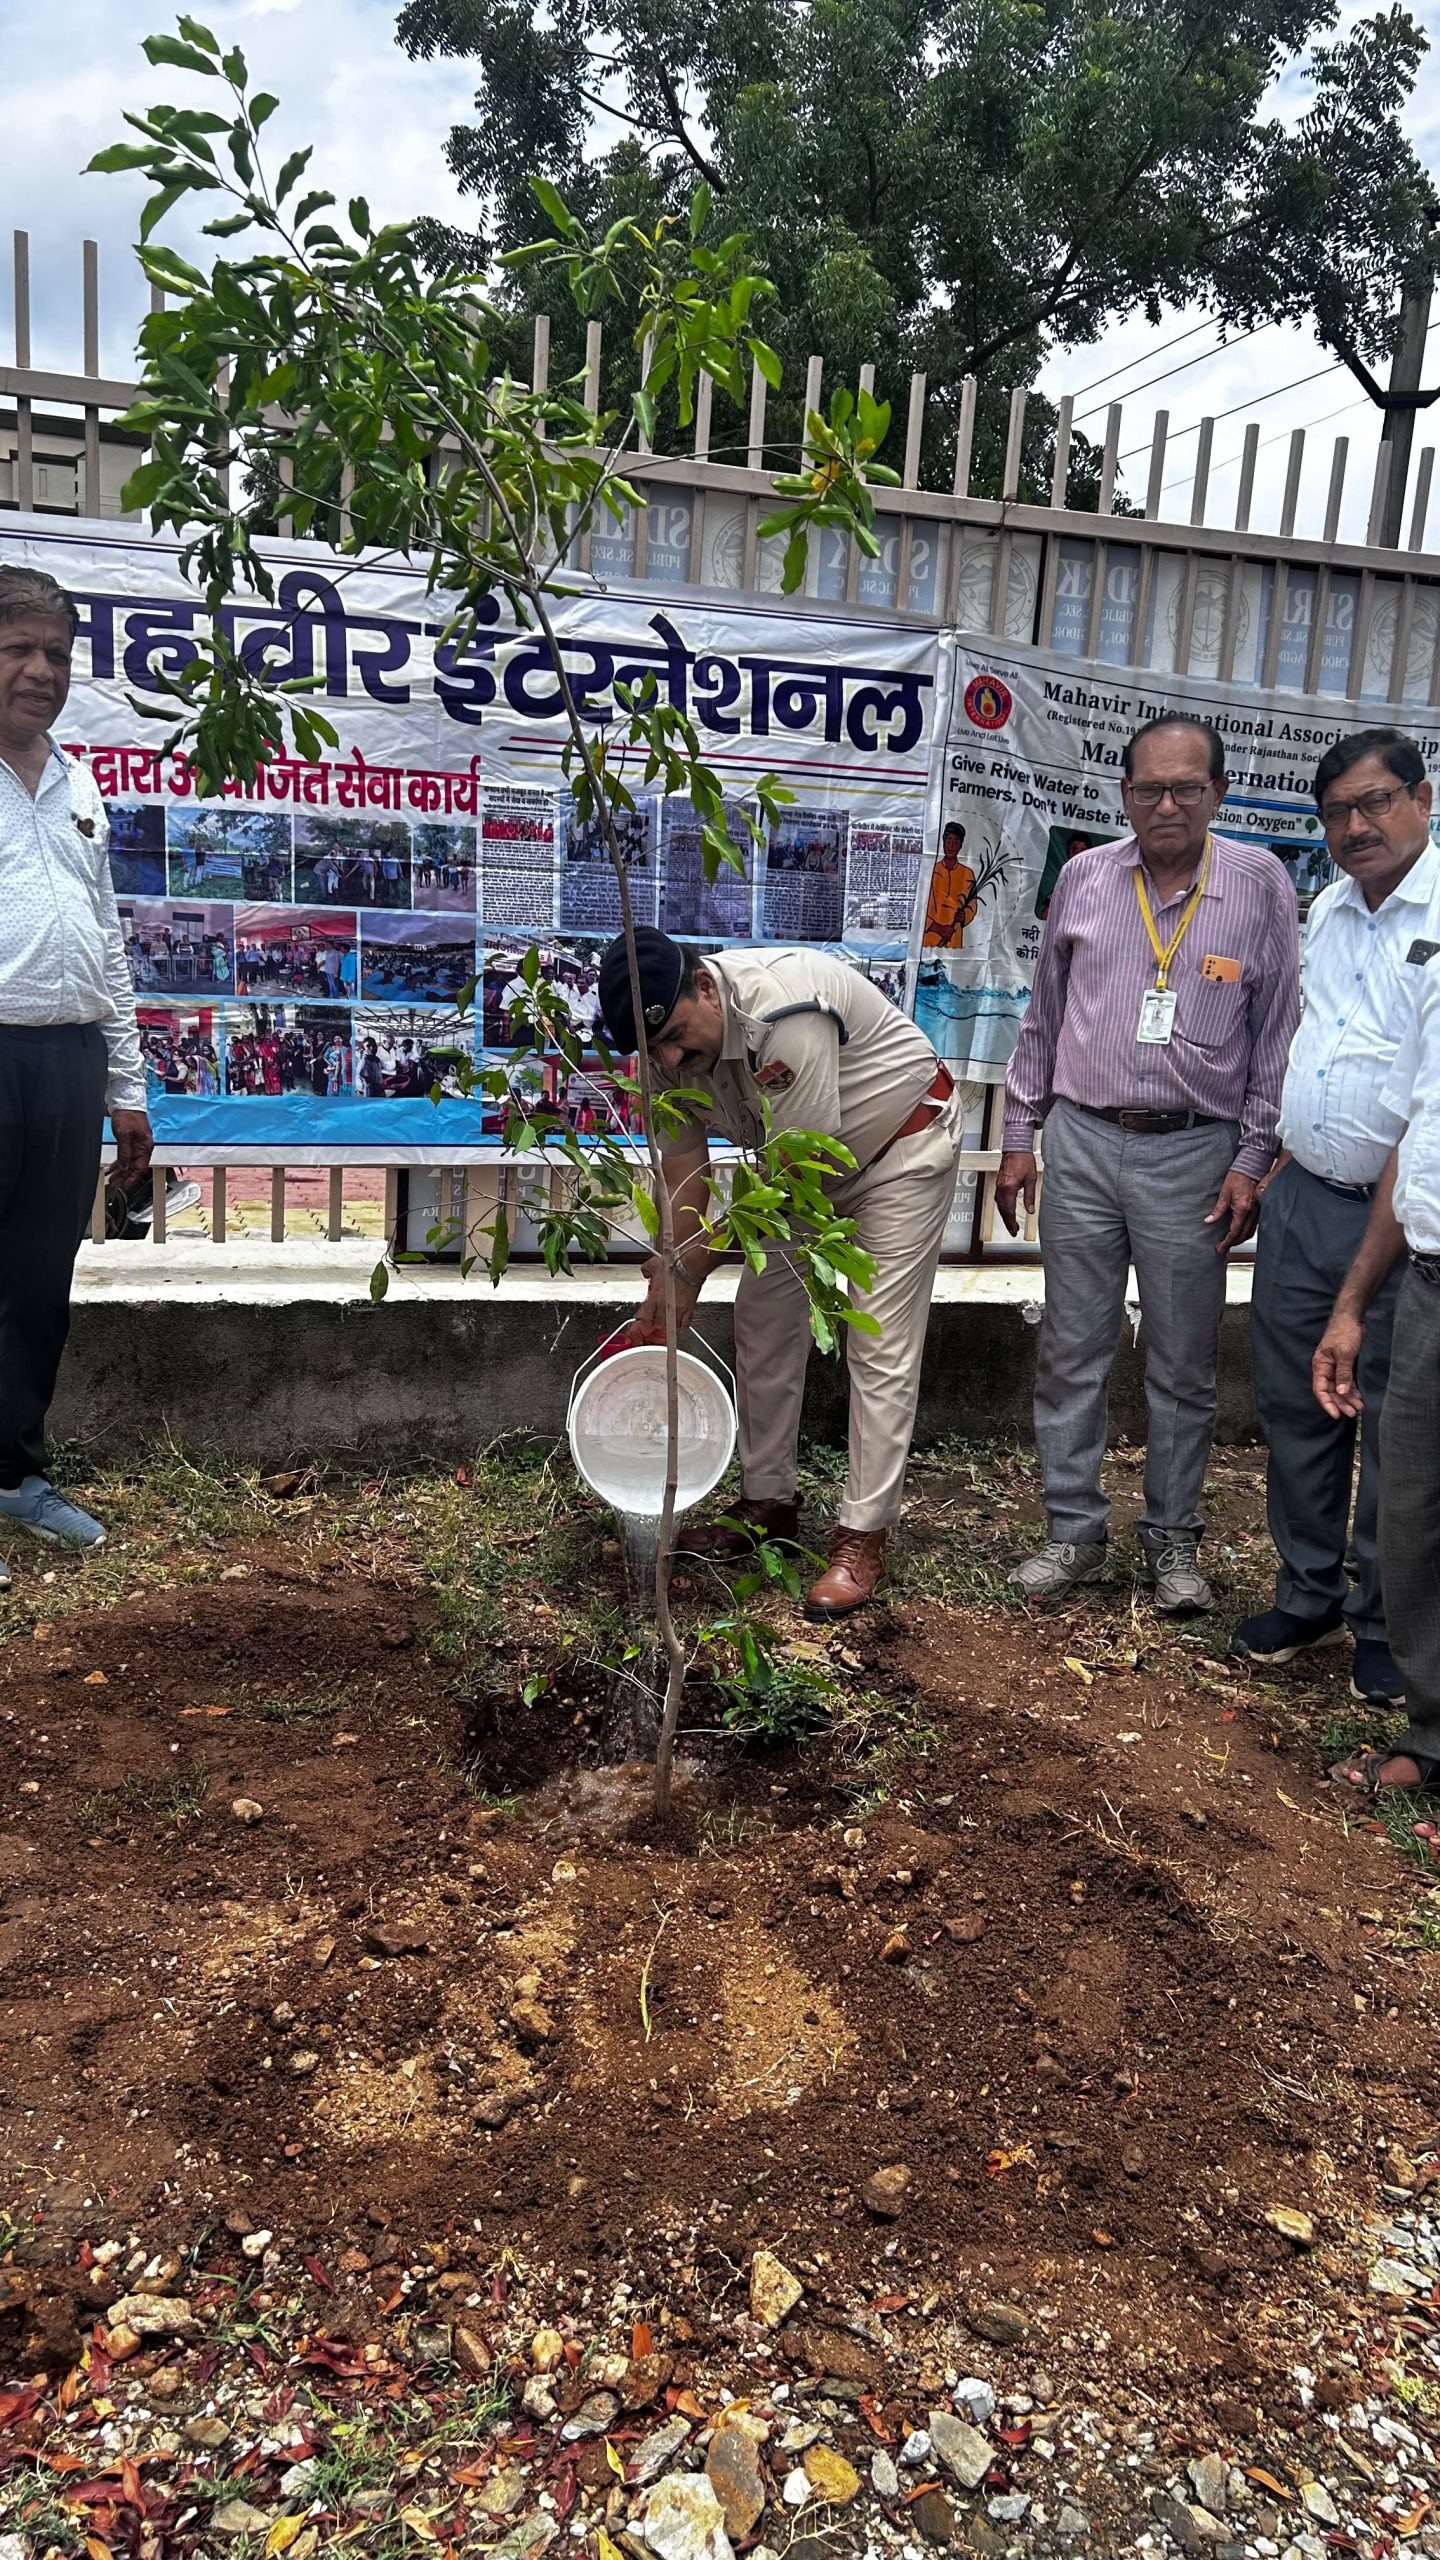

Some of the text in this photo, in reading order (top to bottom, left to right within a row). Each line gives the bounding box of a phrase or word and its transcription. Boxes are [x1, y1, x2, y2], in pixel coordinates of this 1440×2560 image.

[424, 594, 934, 753] इंटरनेशनल
[972, 675, 1010, 699] MAHAVIR
[989, 666, 1010, 678] Serve
[1009, 671, 1019, 680] All
[1042, 681, 1131, 715] Mahavir
[957, 727, 970, 737] Live
[970, 730, 986, 740] And
[986, 732, 998, 742] Let
[1046, 709, 1107, 731] (Registered
[1222, 742, 1248, 754] nder
[1249, 745, 1298, 762] Rajasthan
[334, 745, 402, 811] सेवा
[405, 754, 481, 816] कार्य
[951, 754, 1100, 801] Give River Water to
[950, 778, 1129, 828] Farmers. Don't Waste it.
[1021, 925, 1041, 942] नदी
